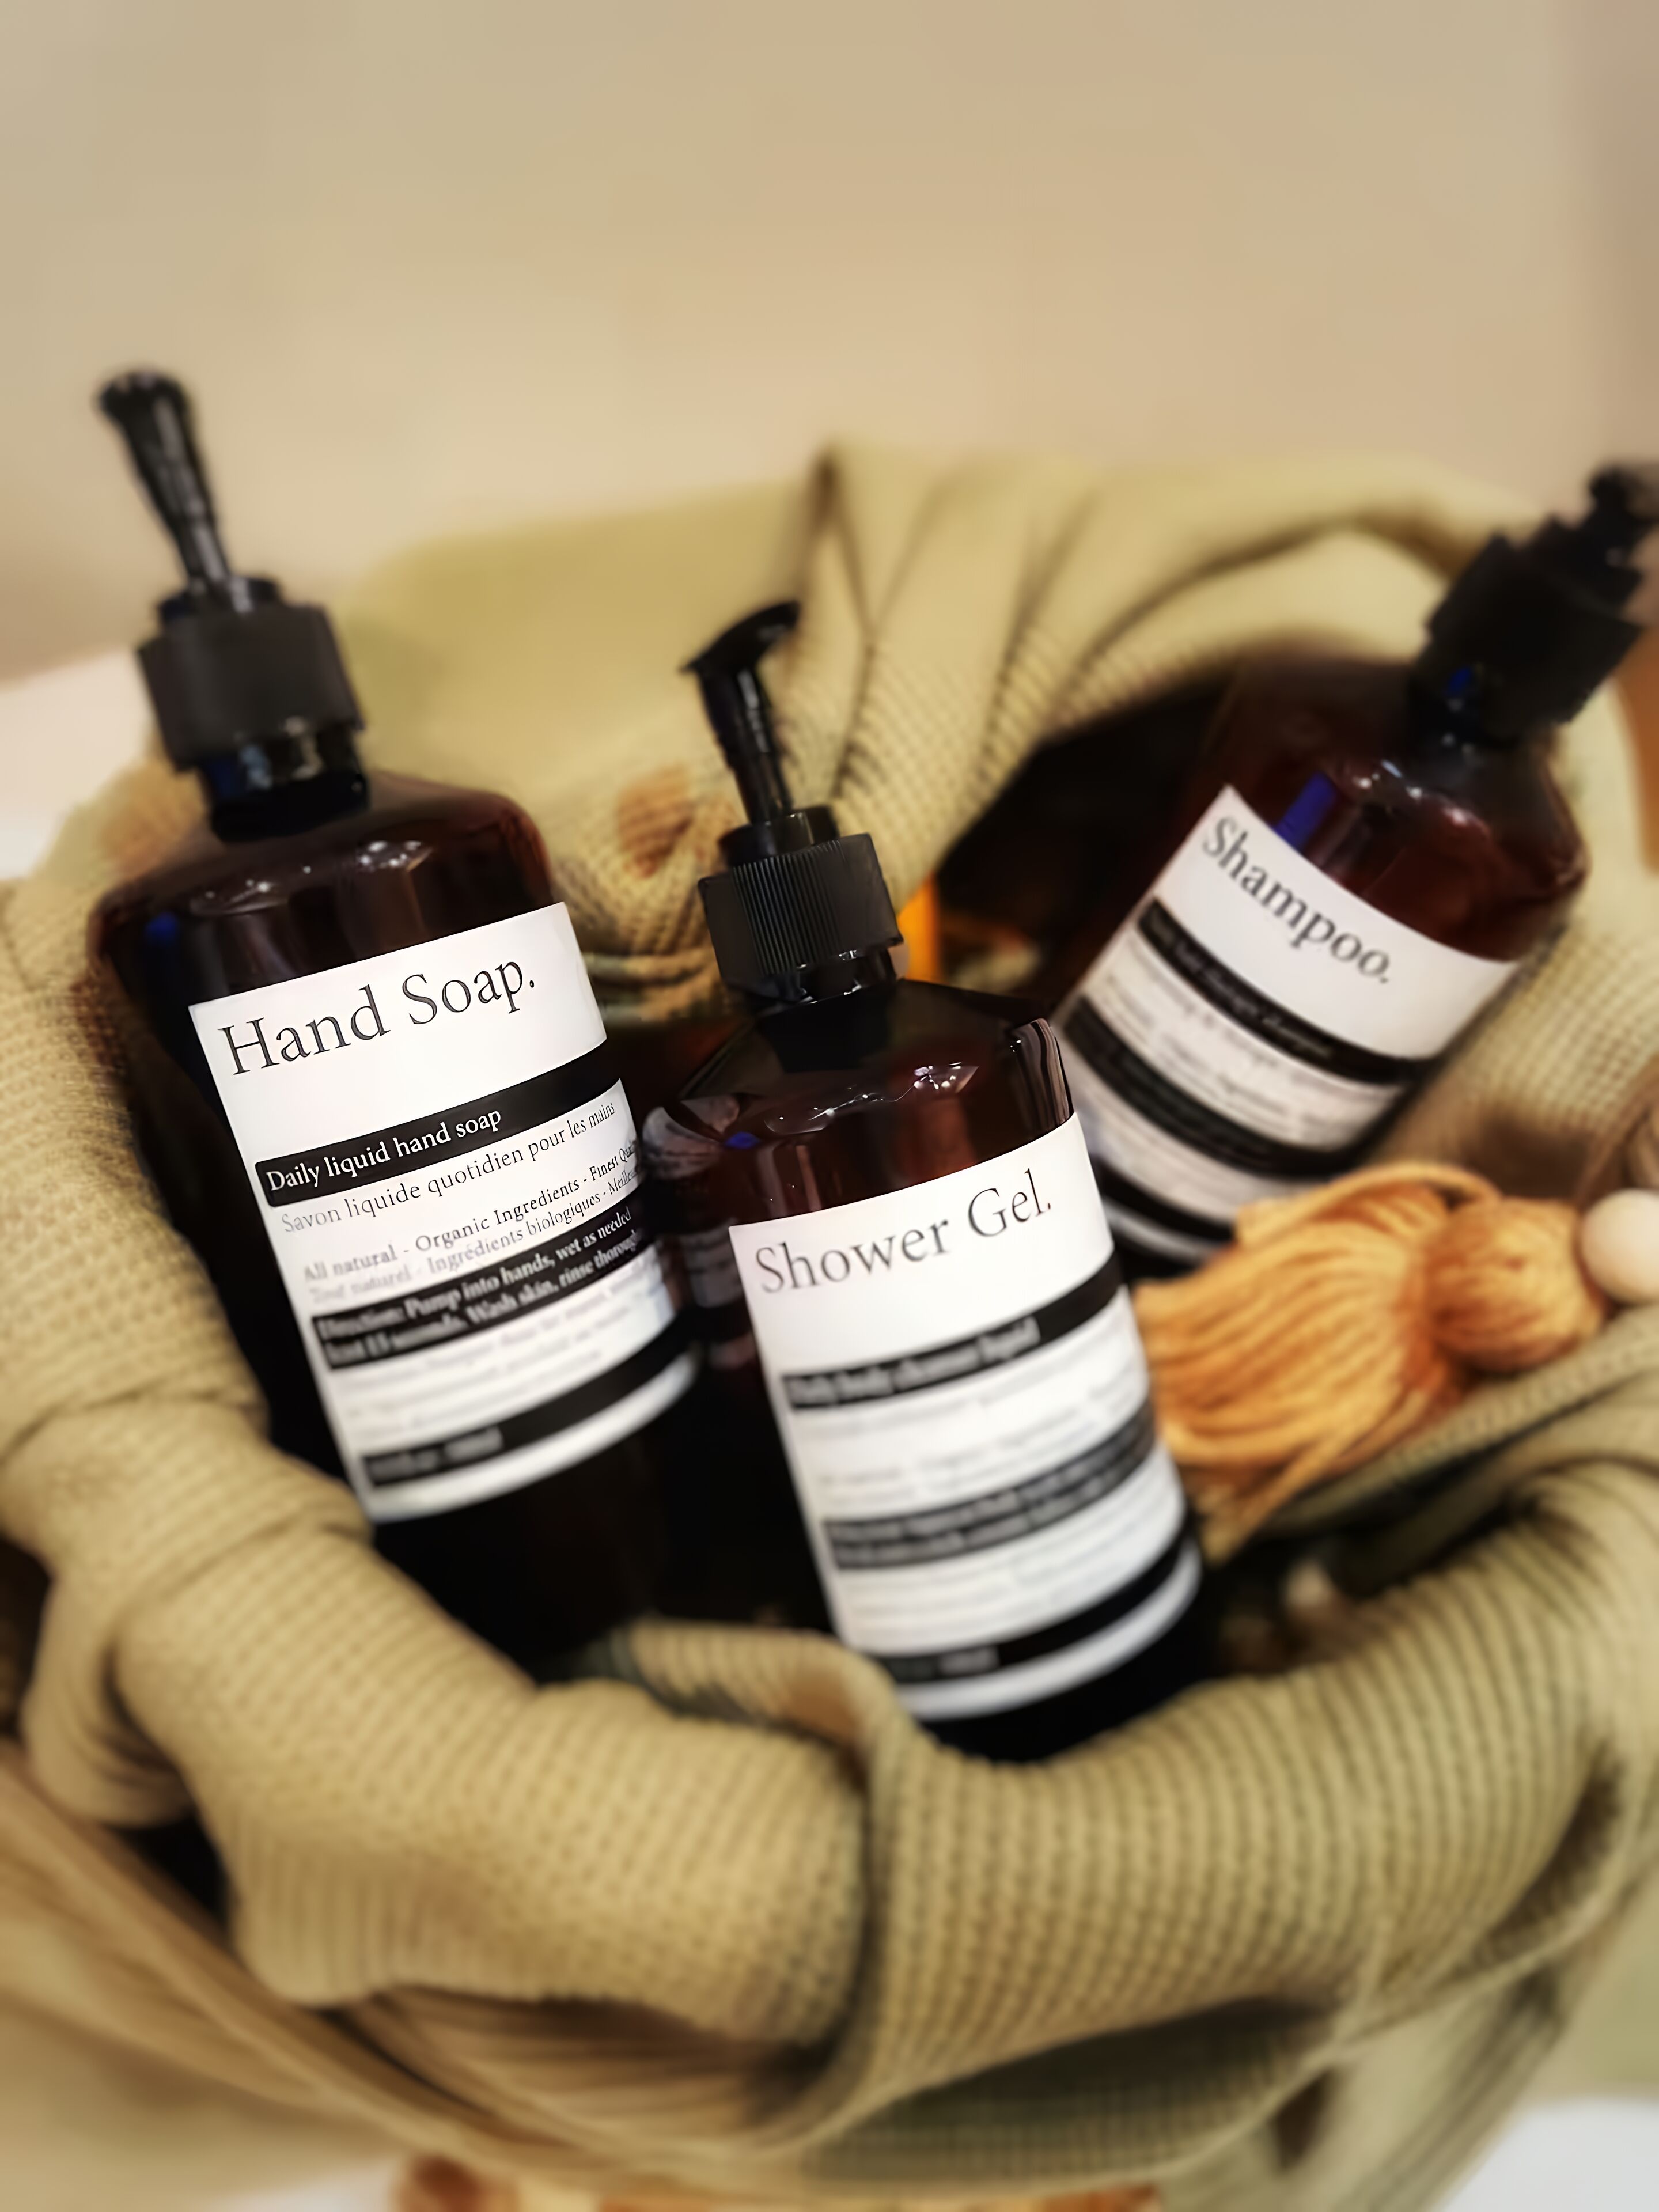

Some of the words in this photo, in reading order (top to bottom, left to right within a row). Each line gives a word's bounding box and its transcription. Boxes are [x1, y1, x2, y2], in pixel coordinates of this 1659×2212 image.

[1202, 816, 1390, 984] Shampoo.
[218, 984, 391, 1075] Hand
[402, 961, 535, 1025] Soap.
[266, 1162, 320, 1191] Daily
[323, 1141, 391, 1178] liquid
[393, 1122, 452, 1157] hand
[455, 1110, 502, 1138] soap
[281, 1208, 342, 1233] Savon
[344, 1182, 422, 1218] liquide
[427, 1149, 524, 1198] quotidien
[528, 1129, 565, 1162] pour
[566, 1119, 587, 1139] les
[332, 1243, 398, 1276] natural
[415, 1218, 490, 1251] Organic
[493, 1179, 580, 1225] Ingredients
[499, 1252, 556, 1285] hands,
[555, 1238, 582, 1261] wet
[582, 1232, 598, 1248] as
[525, 1192, 601, 1236] biologiques
[755, 1218, 950, 1294] Shower
[967, 1167, 1052, 1238] Gel.
